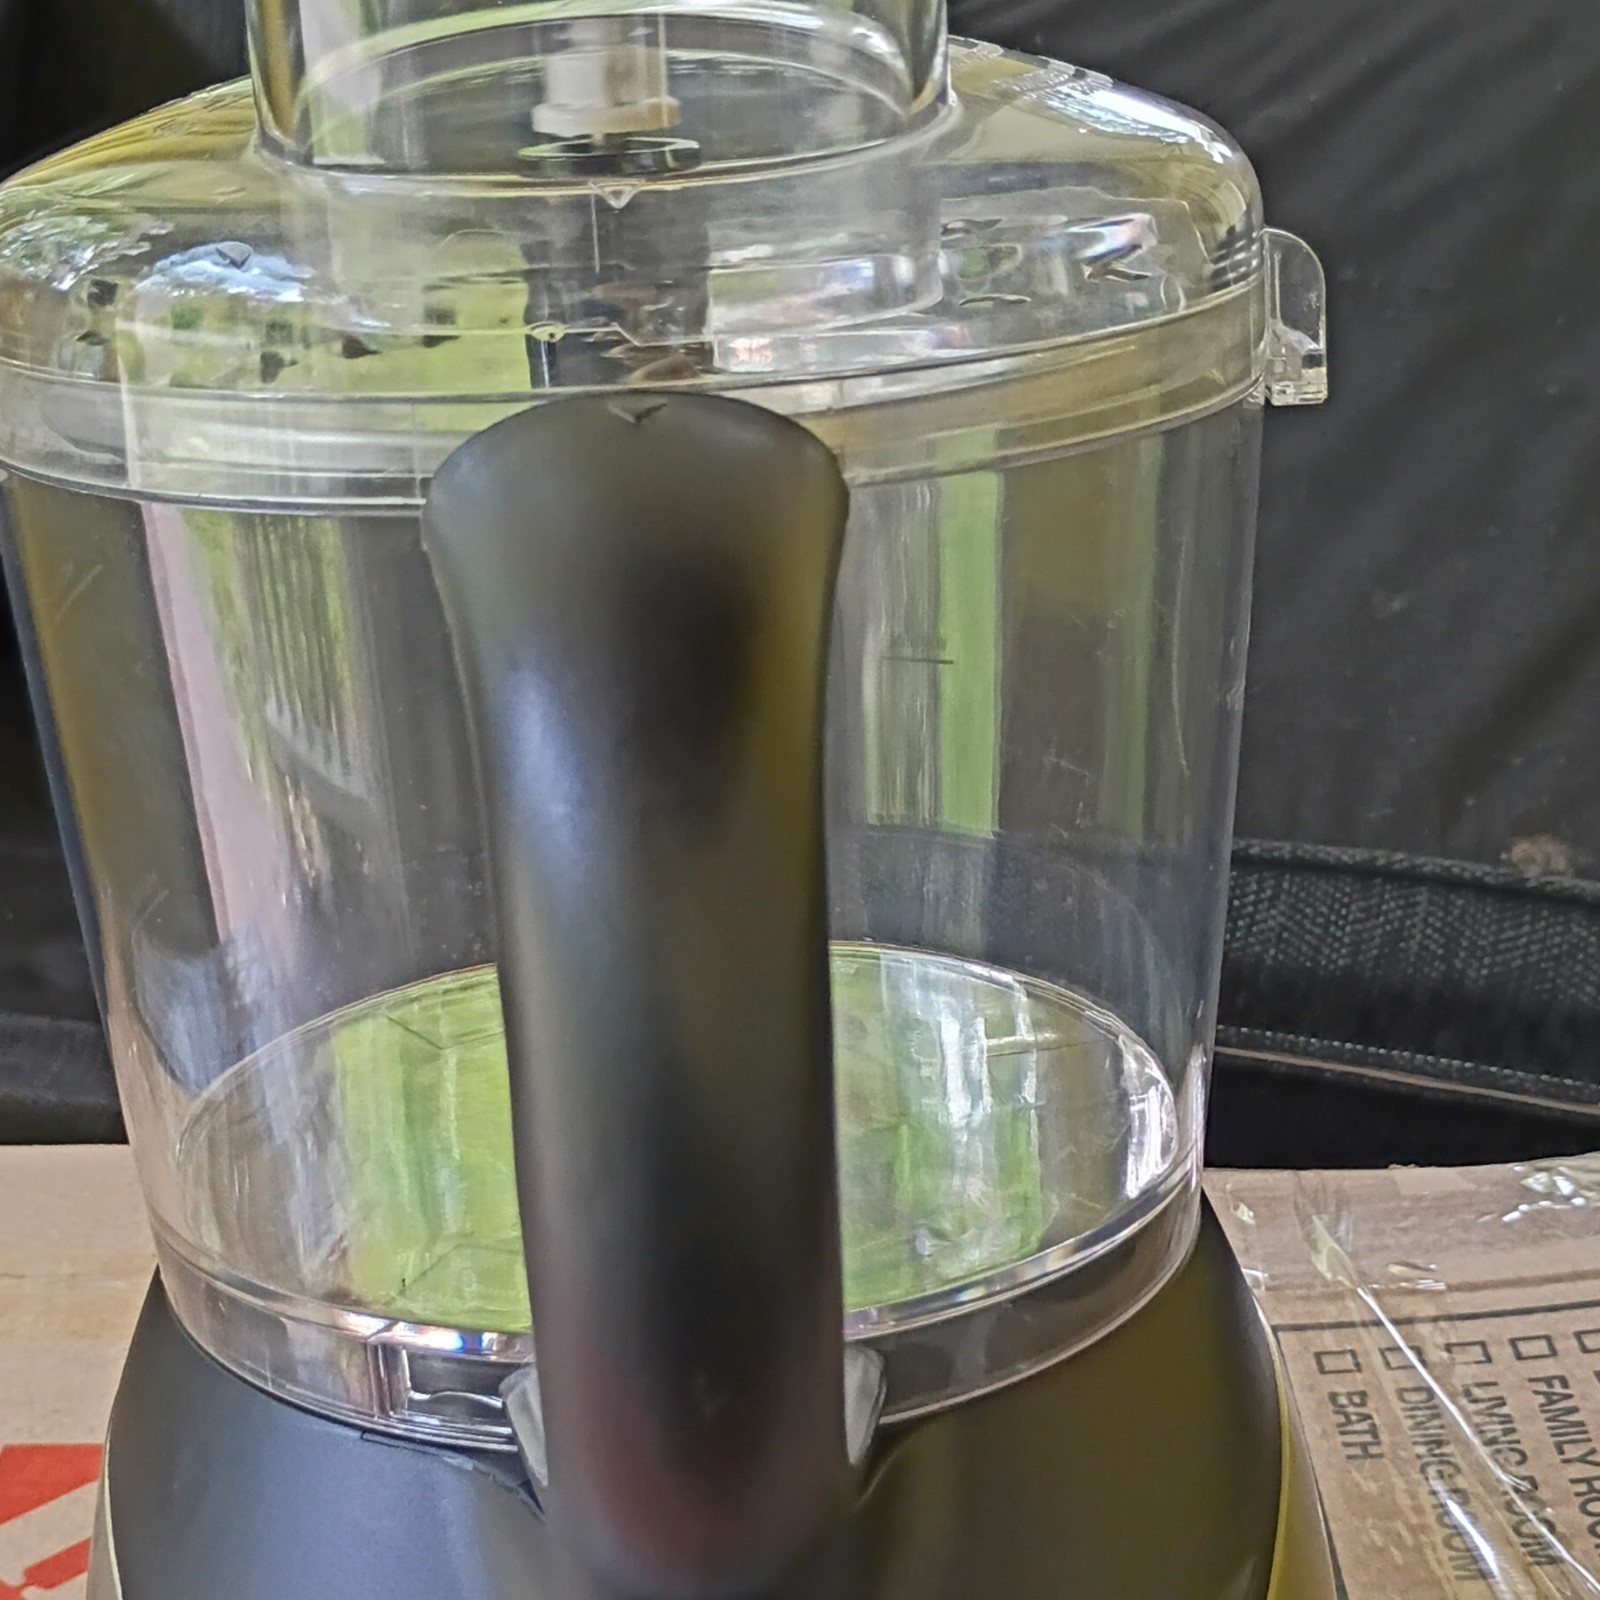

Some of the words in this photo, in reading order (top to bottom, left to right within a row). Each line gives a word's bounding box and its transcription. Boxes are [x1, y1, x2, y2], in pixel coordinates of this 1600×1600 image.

[1327, 1389, 1385, 1461] BATH
[1395, 1386, 1461, 1482] DINING
[1527, 1374, 1600, 1465] FAMILY
[1461, 1380, 1529, 1472] LIVING
[1501, 1474, 1567, 1566] ROOM
